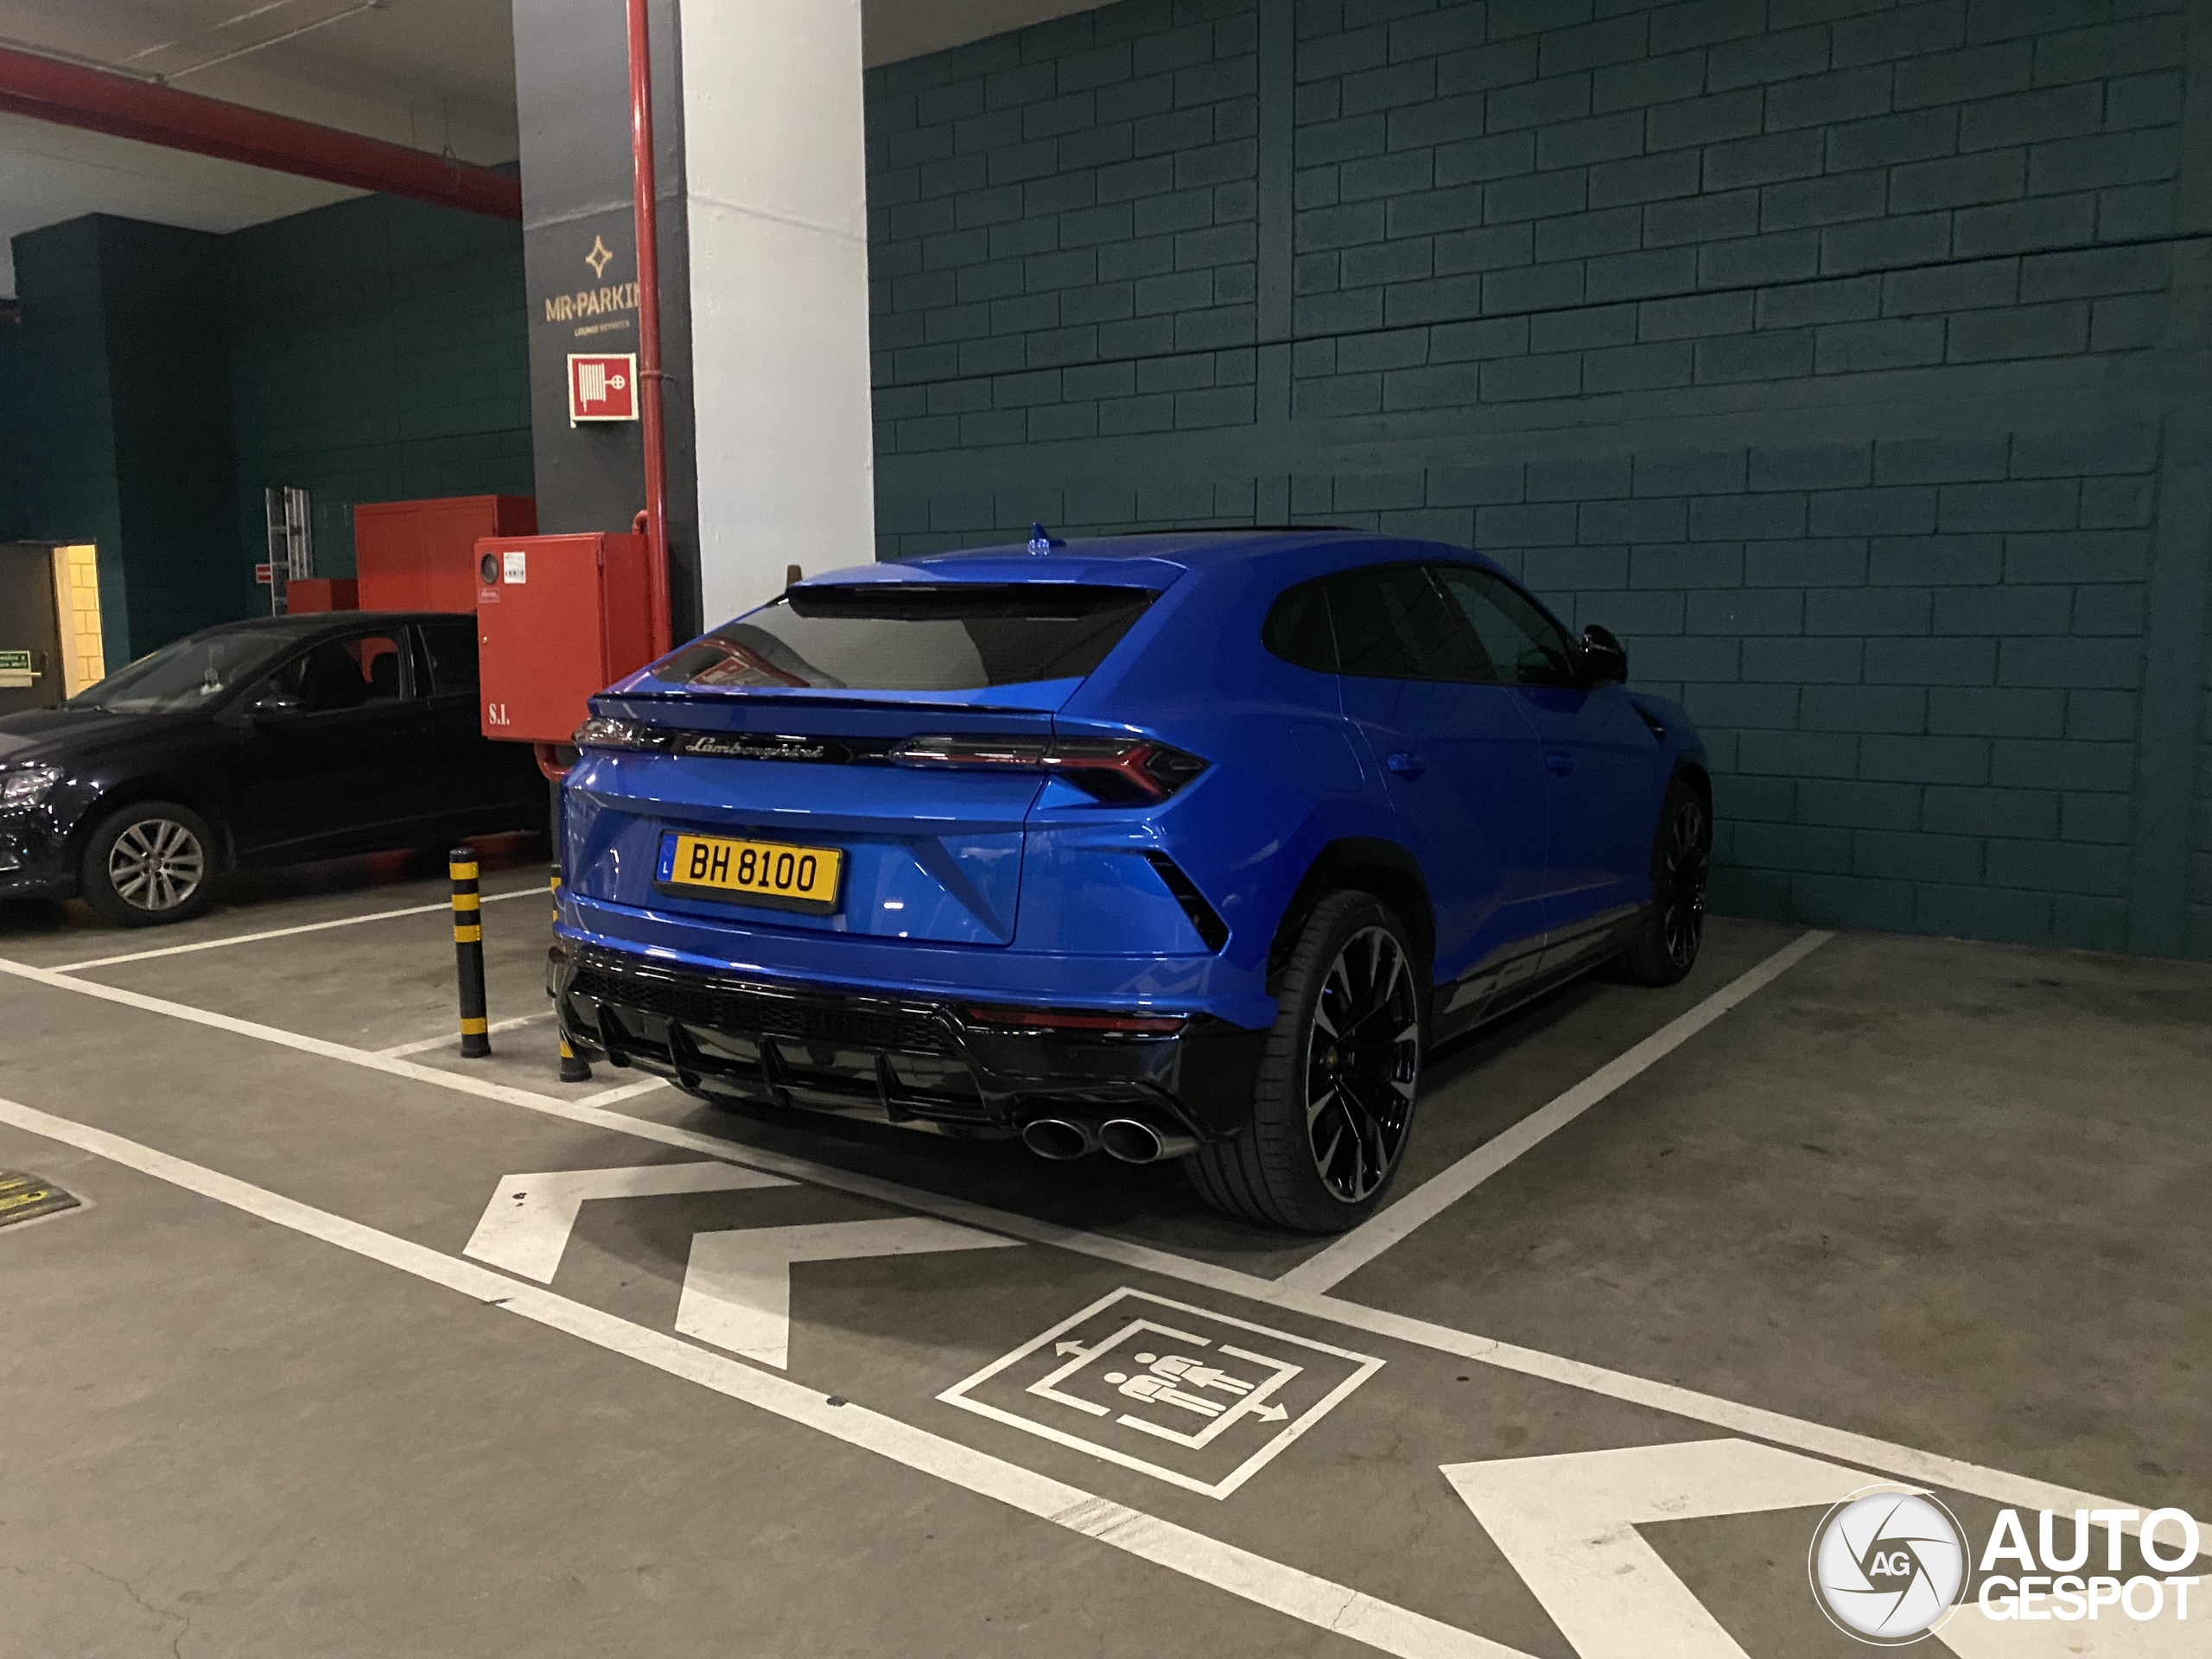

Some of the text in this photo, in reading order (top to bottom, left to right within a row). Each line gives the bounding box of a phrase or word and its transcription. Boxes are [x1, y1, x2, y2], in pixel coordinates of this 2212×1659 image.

[685, 736, 824, 760] Lamborghini
[662, 861, 669, 874] L
[690, 843, 817, 893] BH 8100
